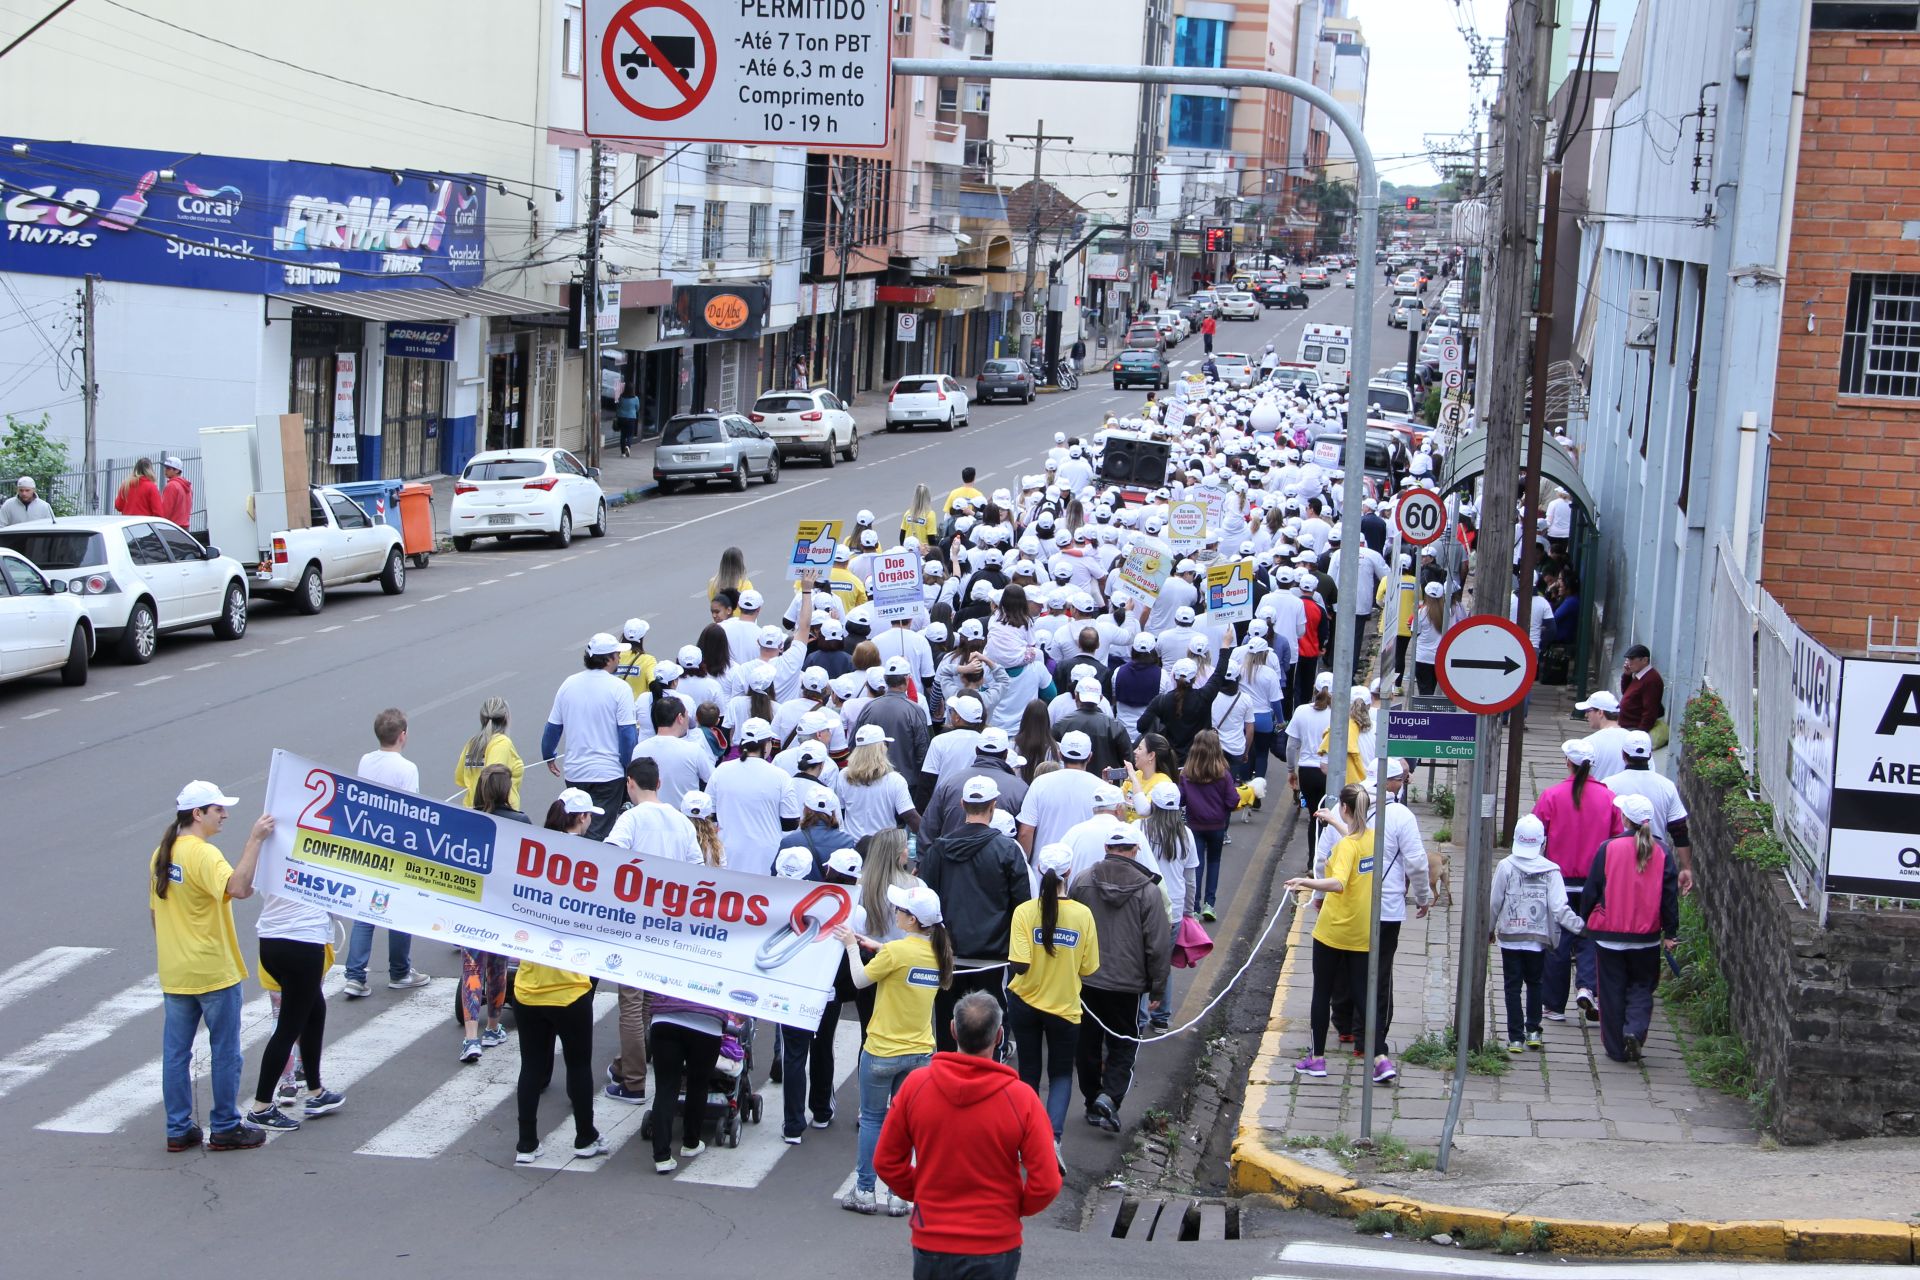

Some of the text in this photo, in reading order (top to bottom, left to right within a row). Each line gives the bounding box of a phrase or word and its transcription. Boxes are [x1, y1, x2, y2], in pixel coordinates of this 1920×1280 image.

[740, 0, 866, 20] PERMITIDO
[734, 31, 871, 52] -Até 7 Ton PBT
[739, 57, 864, 79] -Até 6,3 m de
[738, 85, 865, 108] Comprimento
[763, 113, 784, 131] 10
[801, 114, 820, 132] 19
[826, 115, 838, 133] h
[178, 196, 231, 216] Coral
[455, 208, 477, 226] Coral
[8, 223, 97, 249] TINTAS
[167, 234, 255, 261] Sparlack
[449, 244, 480, 272] Sparlack
[382, 254, 423, 273] TINTAS
[905, 318, 910, 326] E
[390, 329, 441, 341] FORMACO
[1450, 374, 1457, 384] E
[1406, 503, 1437, 531] 60
[885, 558, 905, 569] Doe
[879, 569, 915, 583] Órgãos
[882, 606, 905, 614] HSVP
[1389, 716, 1430, 727] Uruguai
[1435, 746, 1473, 755] B. Centro
[346, 783, 441, 826] Caminhada
[343, 804, 490, 869] Viva a Vida!
[302, 837, 395, 873] CONFIRMADA!
[298, 872, 357, 898] HSVP
[406, 861, 476, 888] Dia 17.10.2015
[516, 837, 769, 926] Doe Órgãos
[284, 883, 303, 895] Hospital
[303, 889, 313, 897] São
[313, 892, 331, 902] Vicente
[331, 897, 338, 905] de
[513, 883, 729, 943] uma corrente pela vida
[453, 922, 500, 942] guerton
[511, 901, 723, 960] Comunique seu desejo a seus familiares
[687, 982, 721, 995] UIRAPURU
